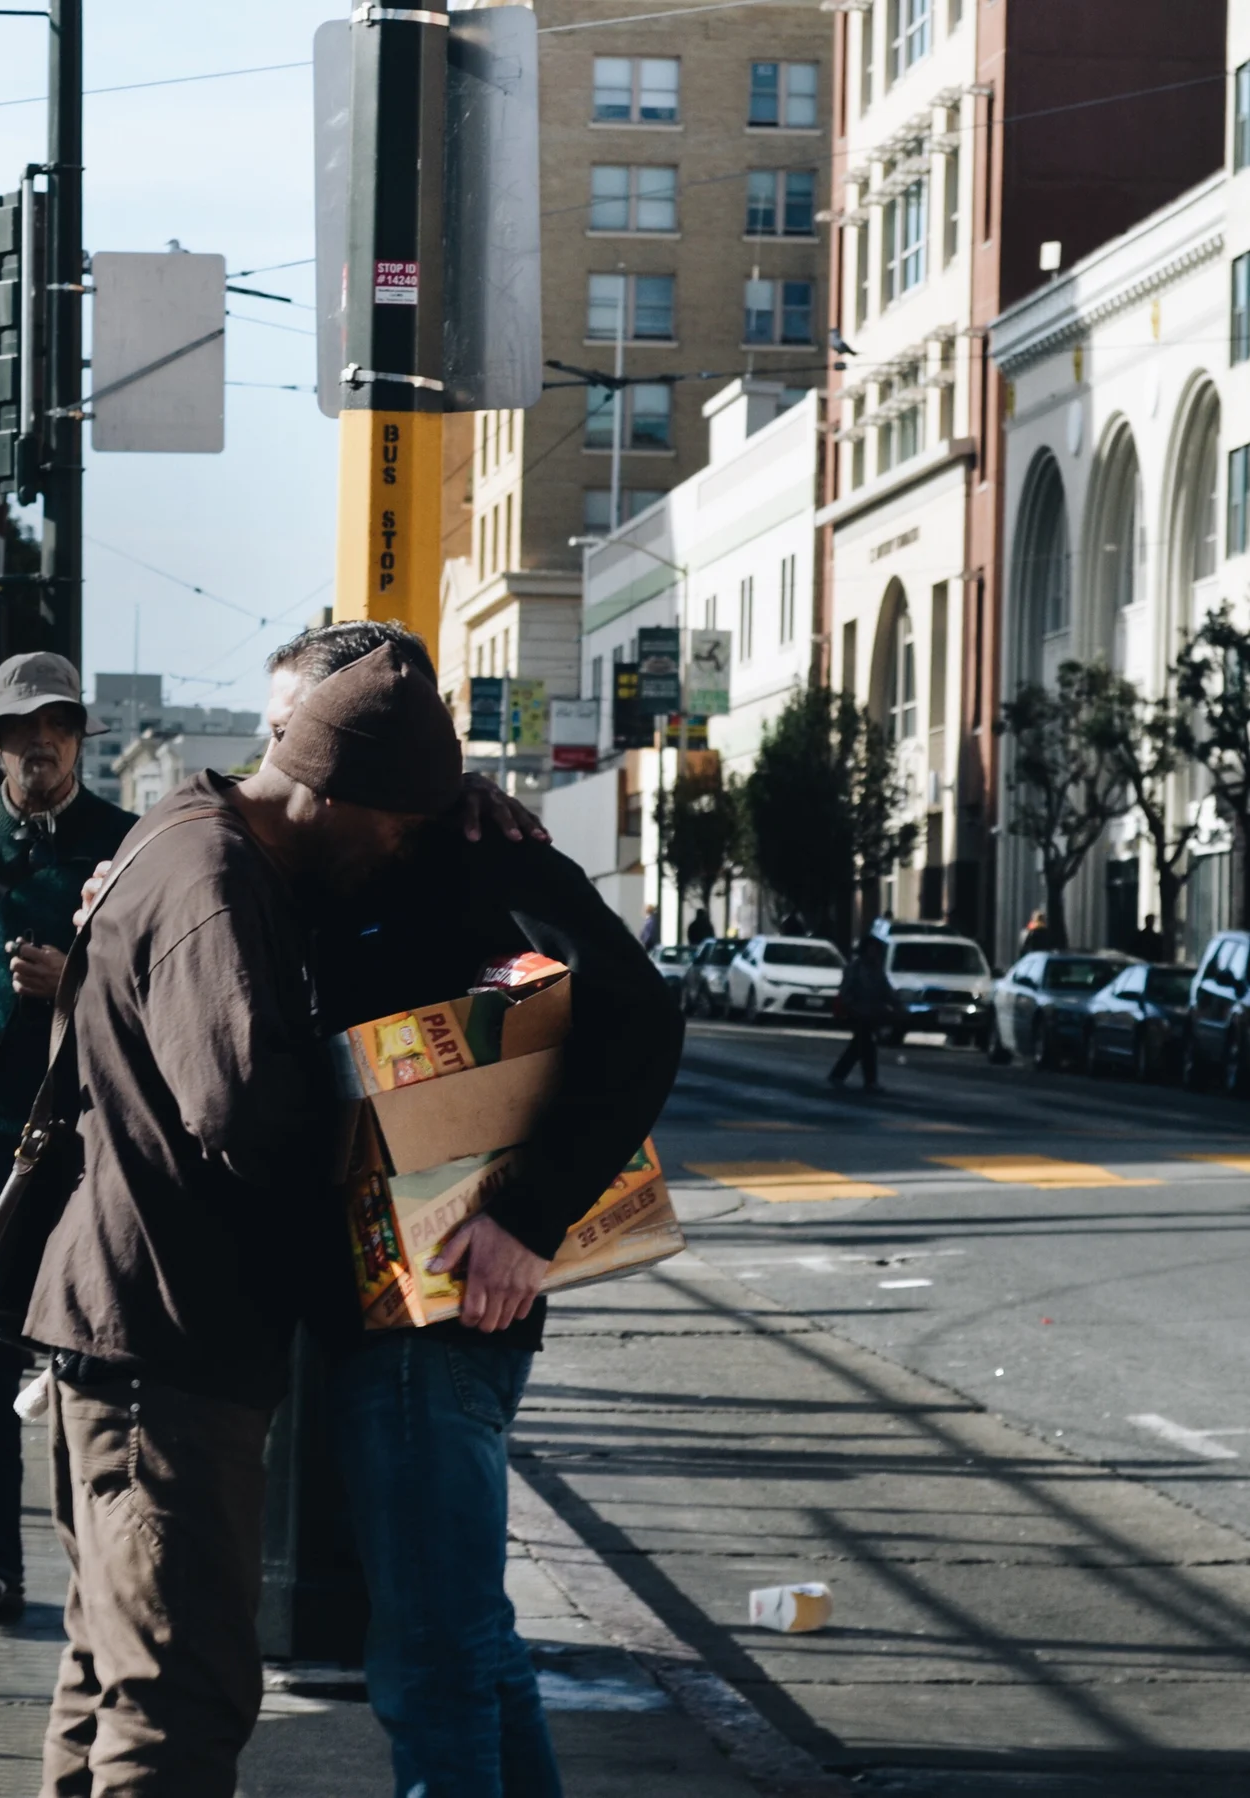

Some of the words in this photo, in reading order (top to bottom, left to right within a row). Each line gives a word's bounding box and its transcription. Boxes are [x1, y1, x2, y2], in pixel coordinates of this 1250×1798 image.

[376, 274, 418, 286] #14240
[377, 262, 404, 273] STOP
[405, 263, 417, 274] ID
[382, 424, 400, 485] BUS
[380, 510, 397, 592] STOP
[410, 1187, 472, 1248] PARTY
[577, 1226, 599, 1248] 32
[599, 1186, 656, 1235] SINGLES
